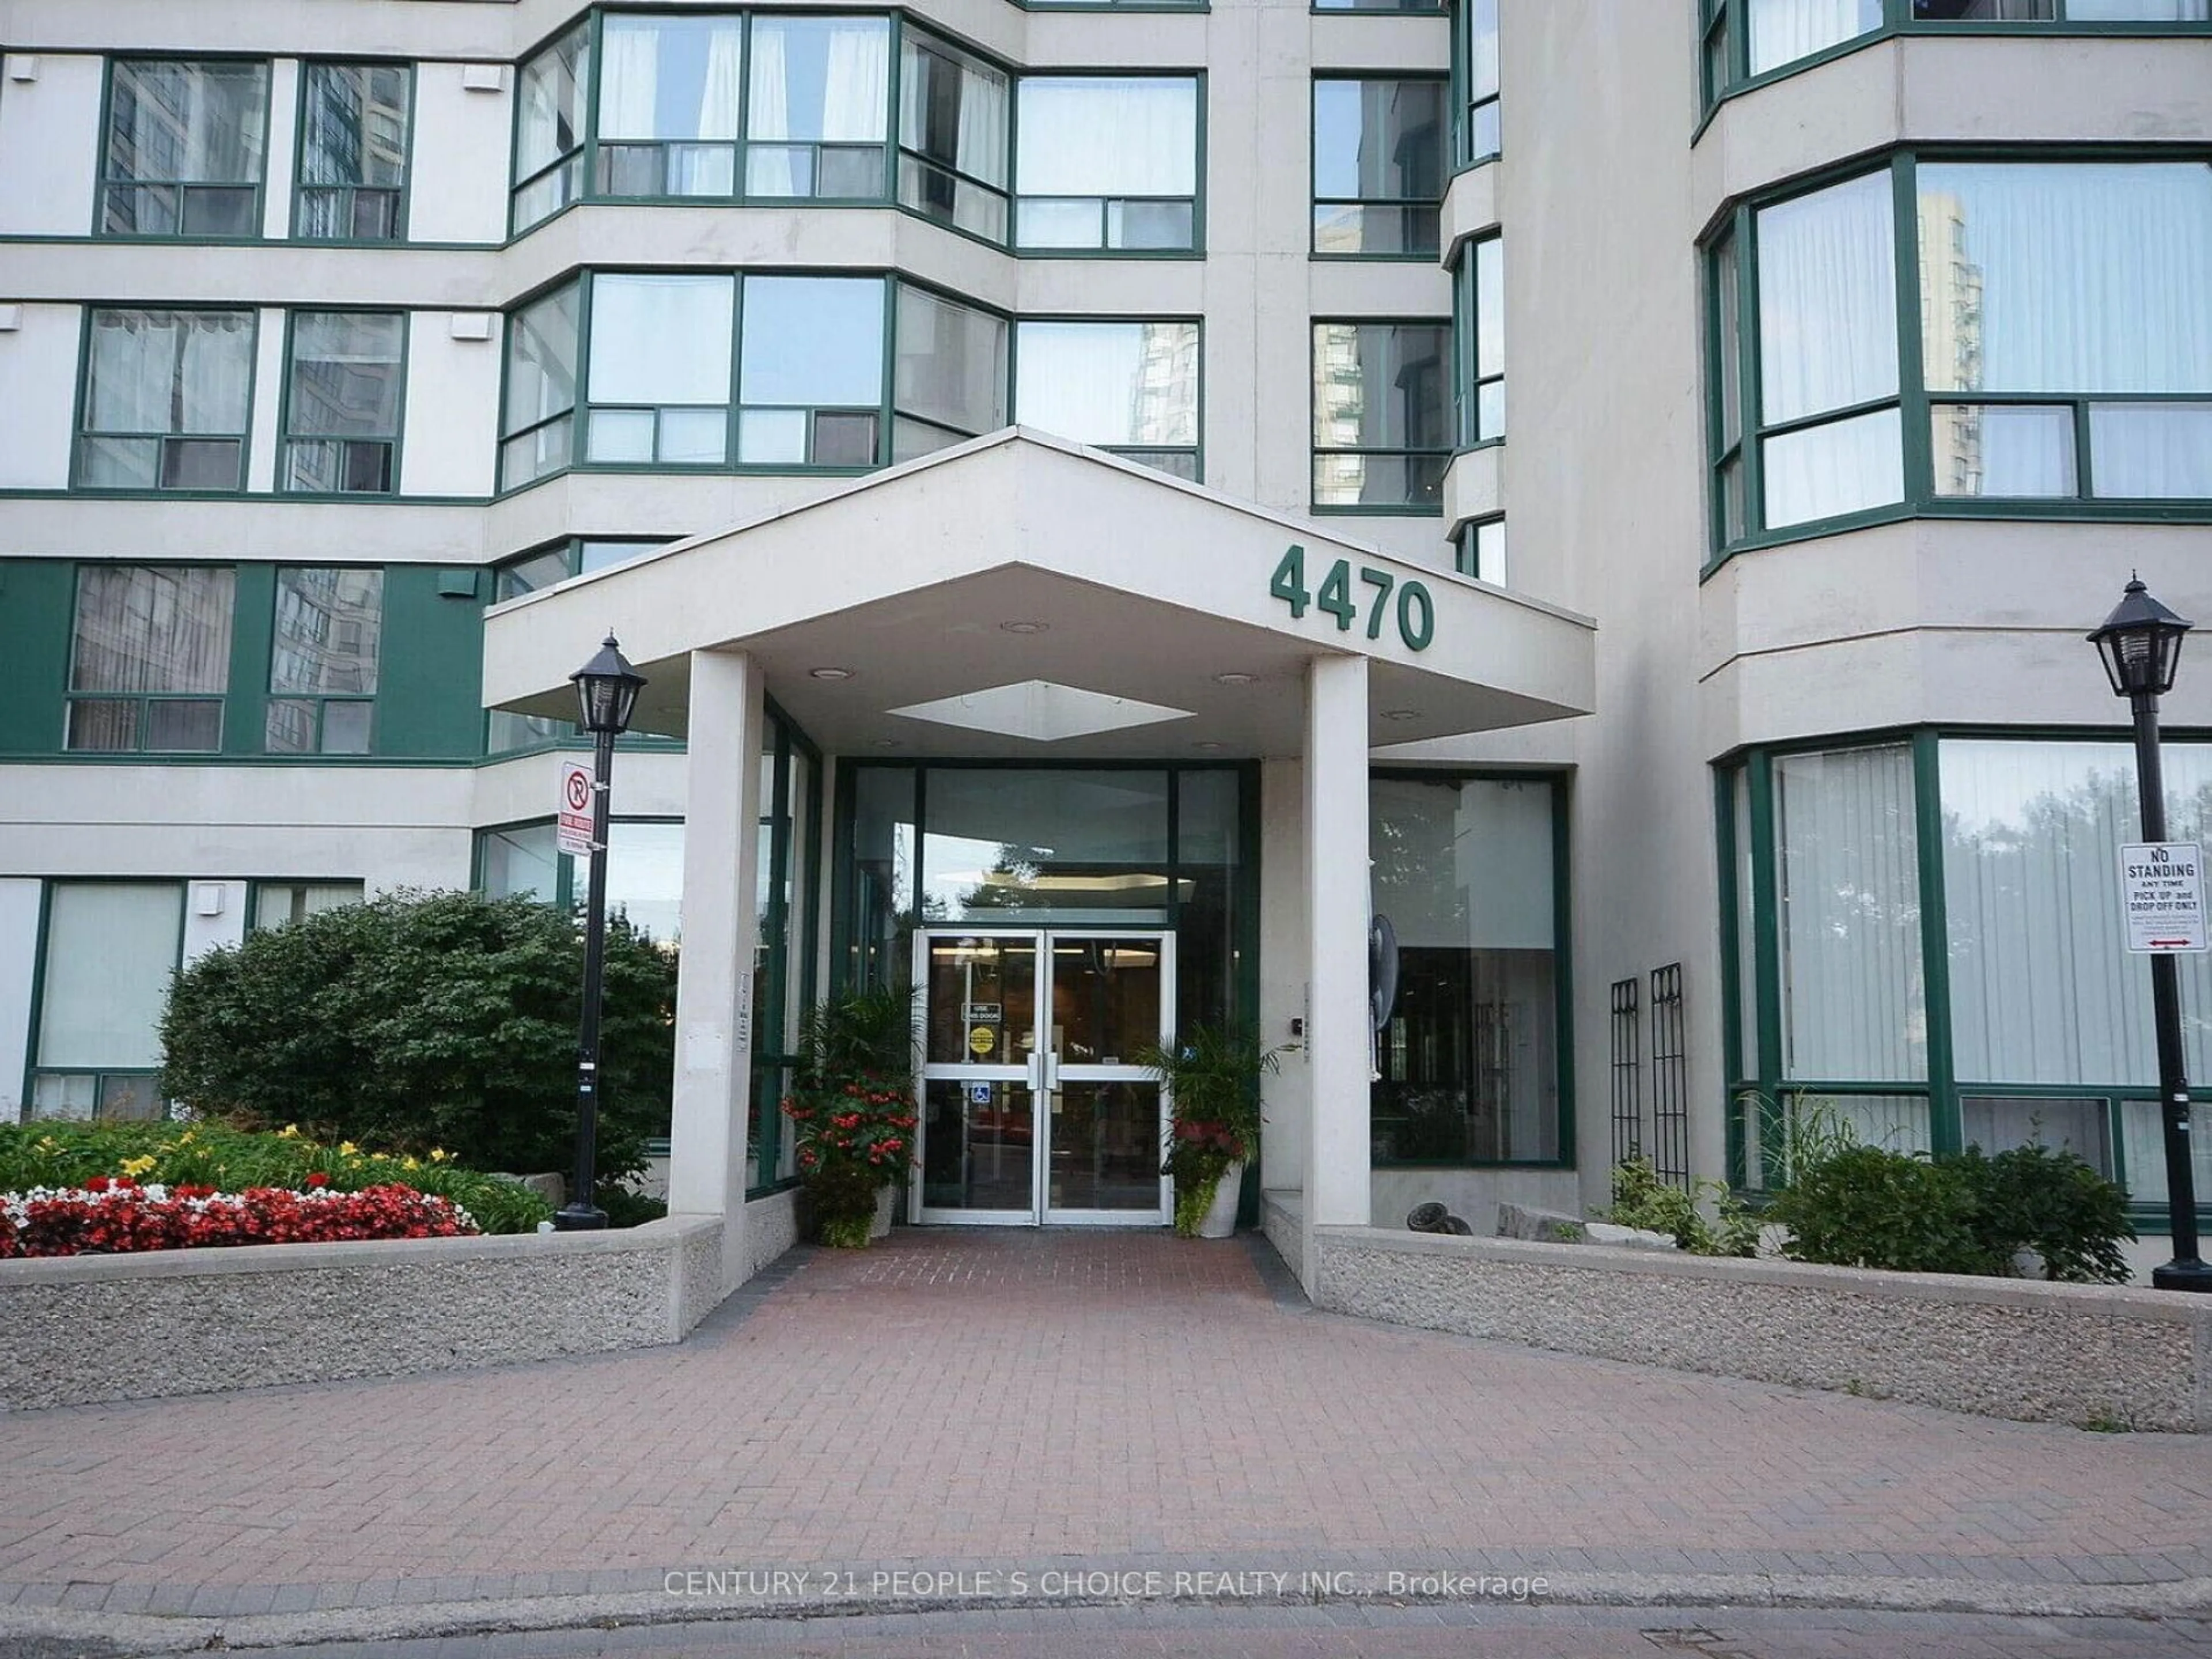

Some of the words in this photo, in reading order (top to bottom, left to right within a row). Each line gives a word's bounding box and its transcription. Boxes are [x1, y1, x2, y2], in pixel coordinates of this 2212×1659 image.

[1271, 544, 1434, 652] 4470
[2150, 849, 2169, 862] NO
[2128, 864, 2194, 878] STANDING
